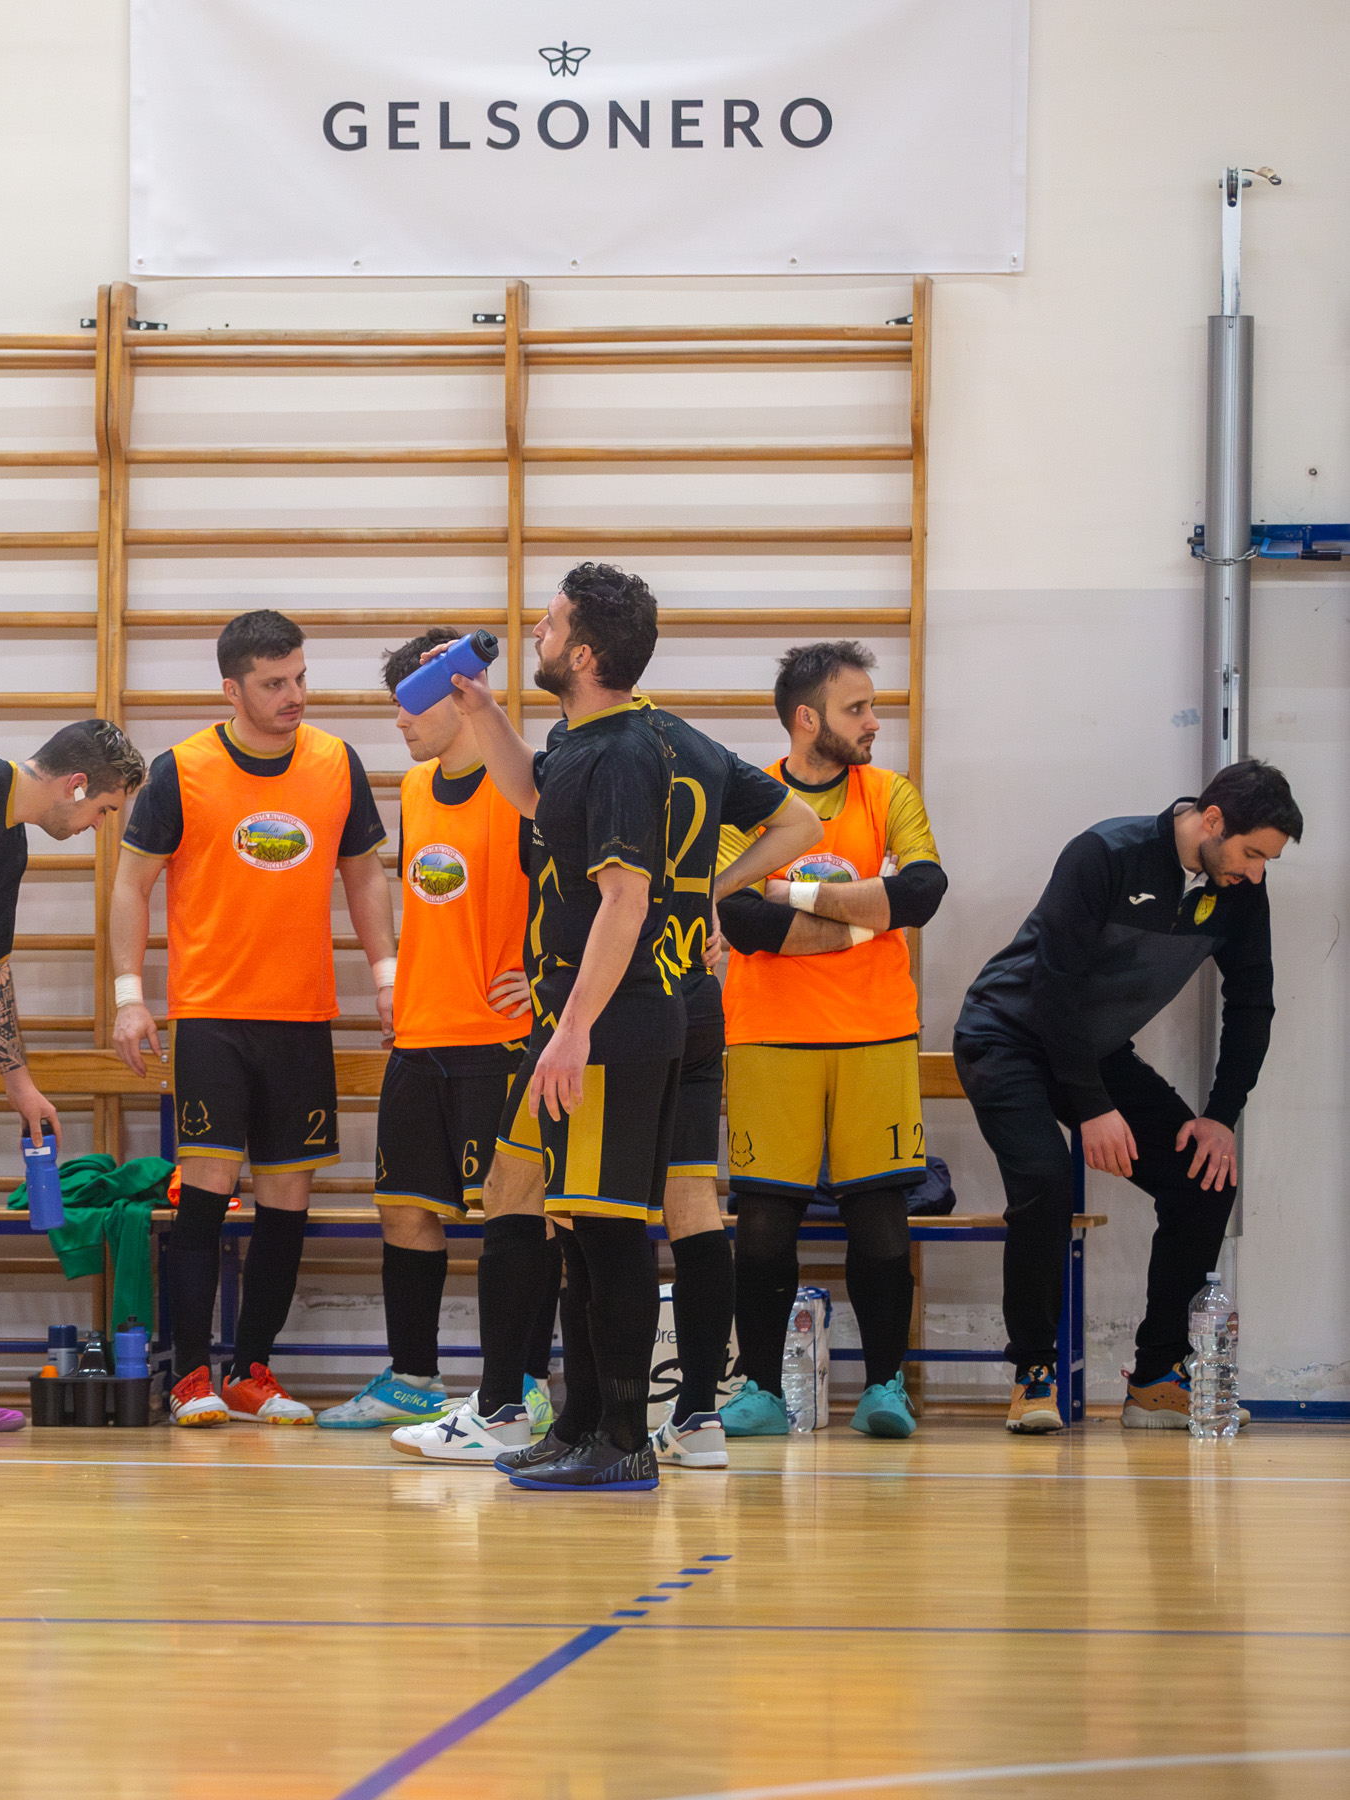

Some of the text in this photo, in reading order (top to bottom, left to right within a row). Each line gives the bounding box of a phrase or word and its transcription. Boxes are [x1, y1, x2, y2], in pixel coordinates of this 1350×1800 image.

[322, 96, 835, 152] GELSONERO
[462, 1139, 479, 1178] 6
[886, 1122, 925, 1160] 12
